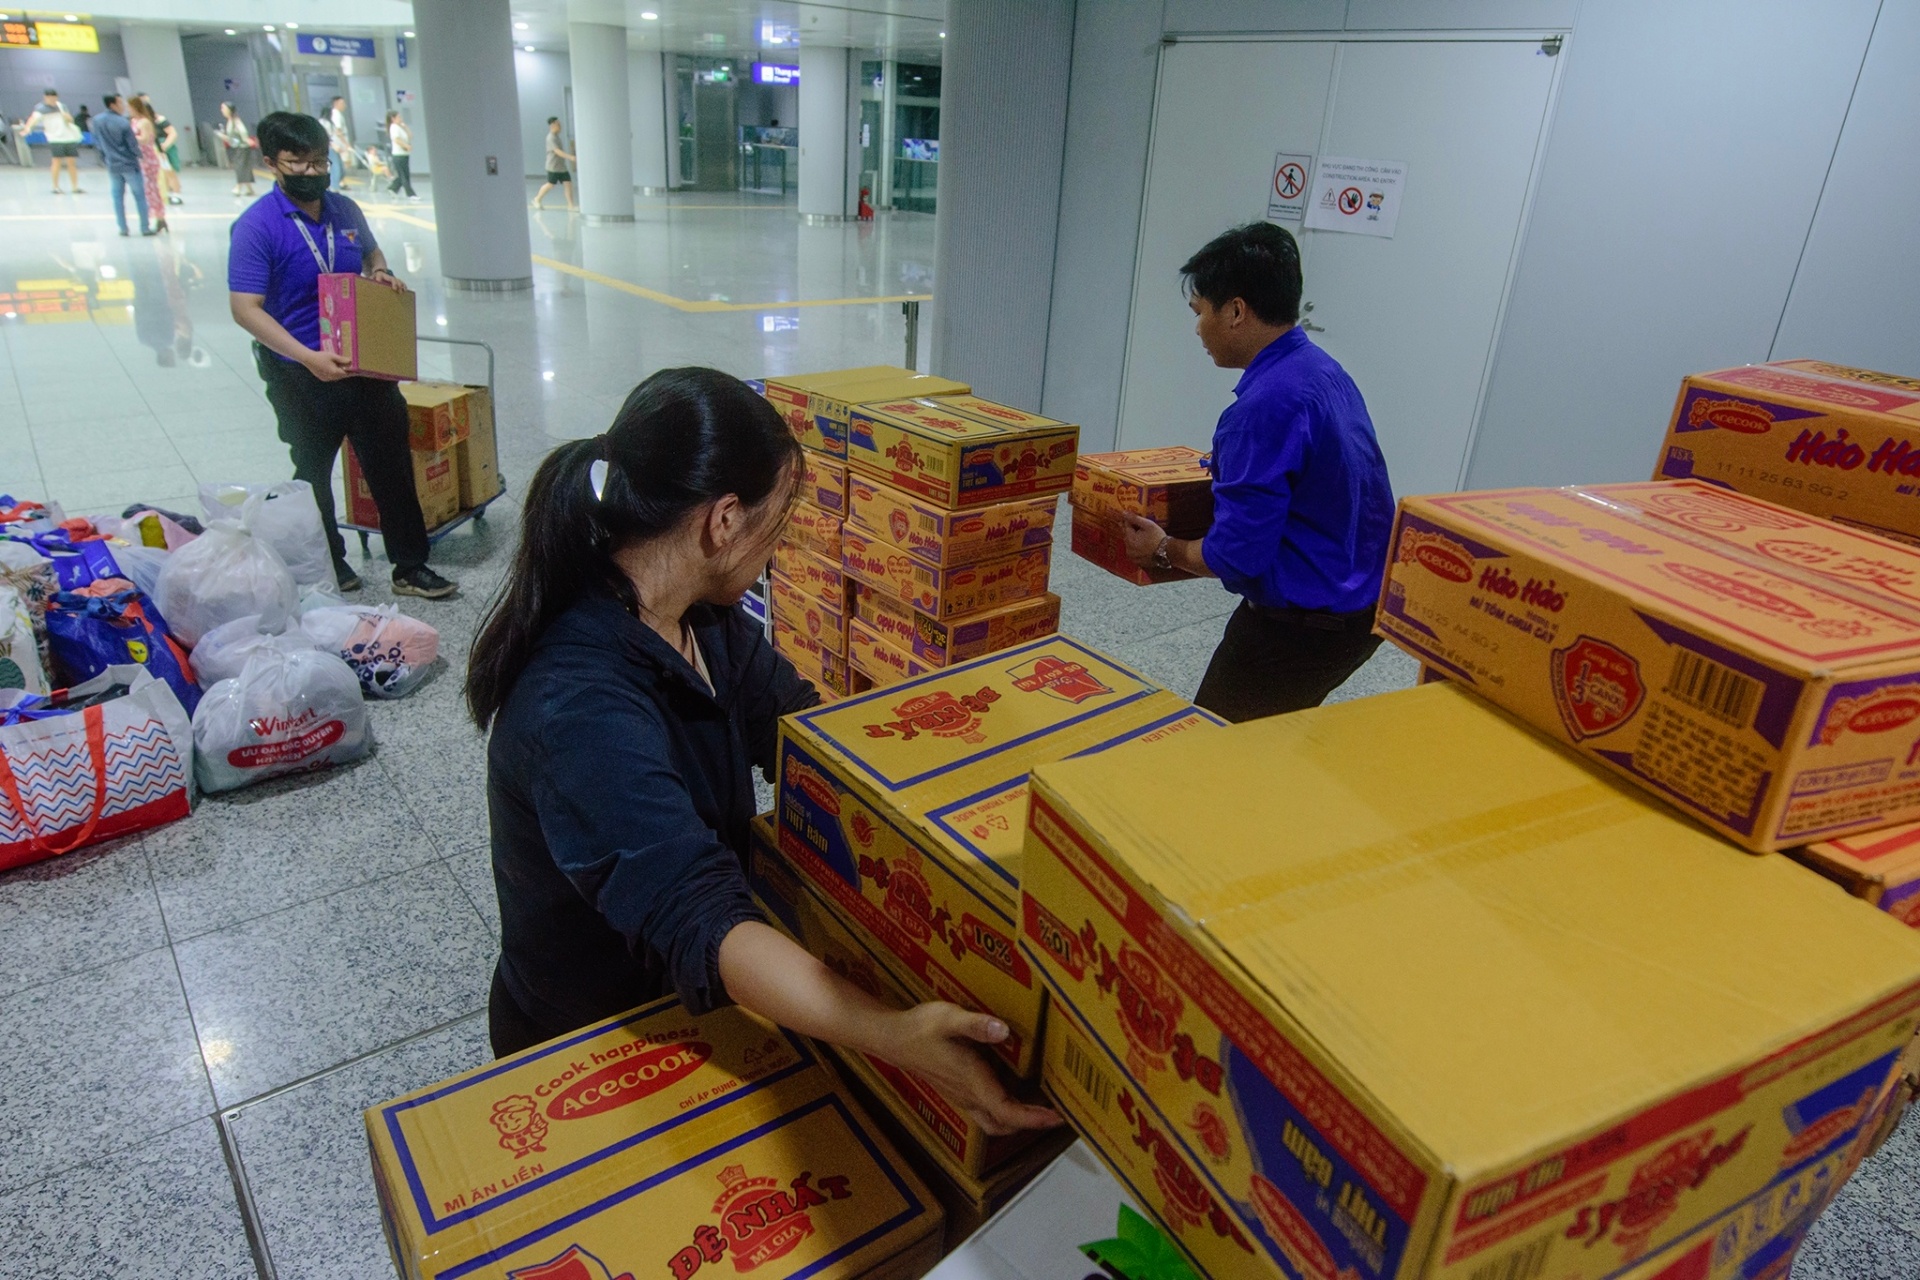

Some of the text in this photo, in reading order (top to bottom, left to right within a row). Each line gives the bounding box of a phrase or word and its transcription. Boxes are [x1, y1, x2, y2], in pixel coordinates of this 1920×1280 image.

[1785, 427, 1866, 471] Hảo
[1759, 471, 1778, 485] 25
[1808, 482, 1833, 498] SG
[1837, 490, 1848, 501] 2
[1477, 564, 1565, 614] Hảo Hảo
[862, 685, 1002, 741] ĐỆ NHẤT
[857, 853, 891, 890] ĐỆ
[974, 925, 1014, 968] 10%
[534, 1026, 700, 1097] Cook happiness
[443, 1162, 545, 1213] MÌ ĂN LIỀN
[667, 1170, 853, 1280] ĐỆ NHẤT
[750, 1224, 802, 1268] MÌ GIA
